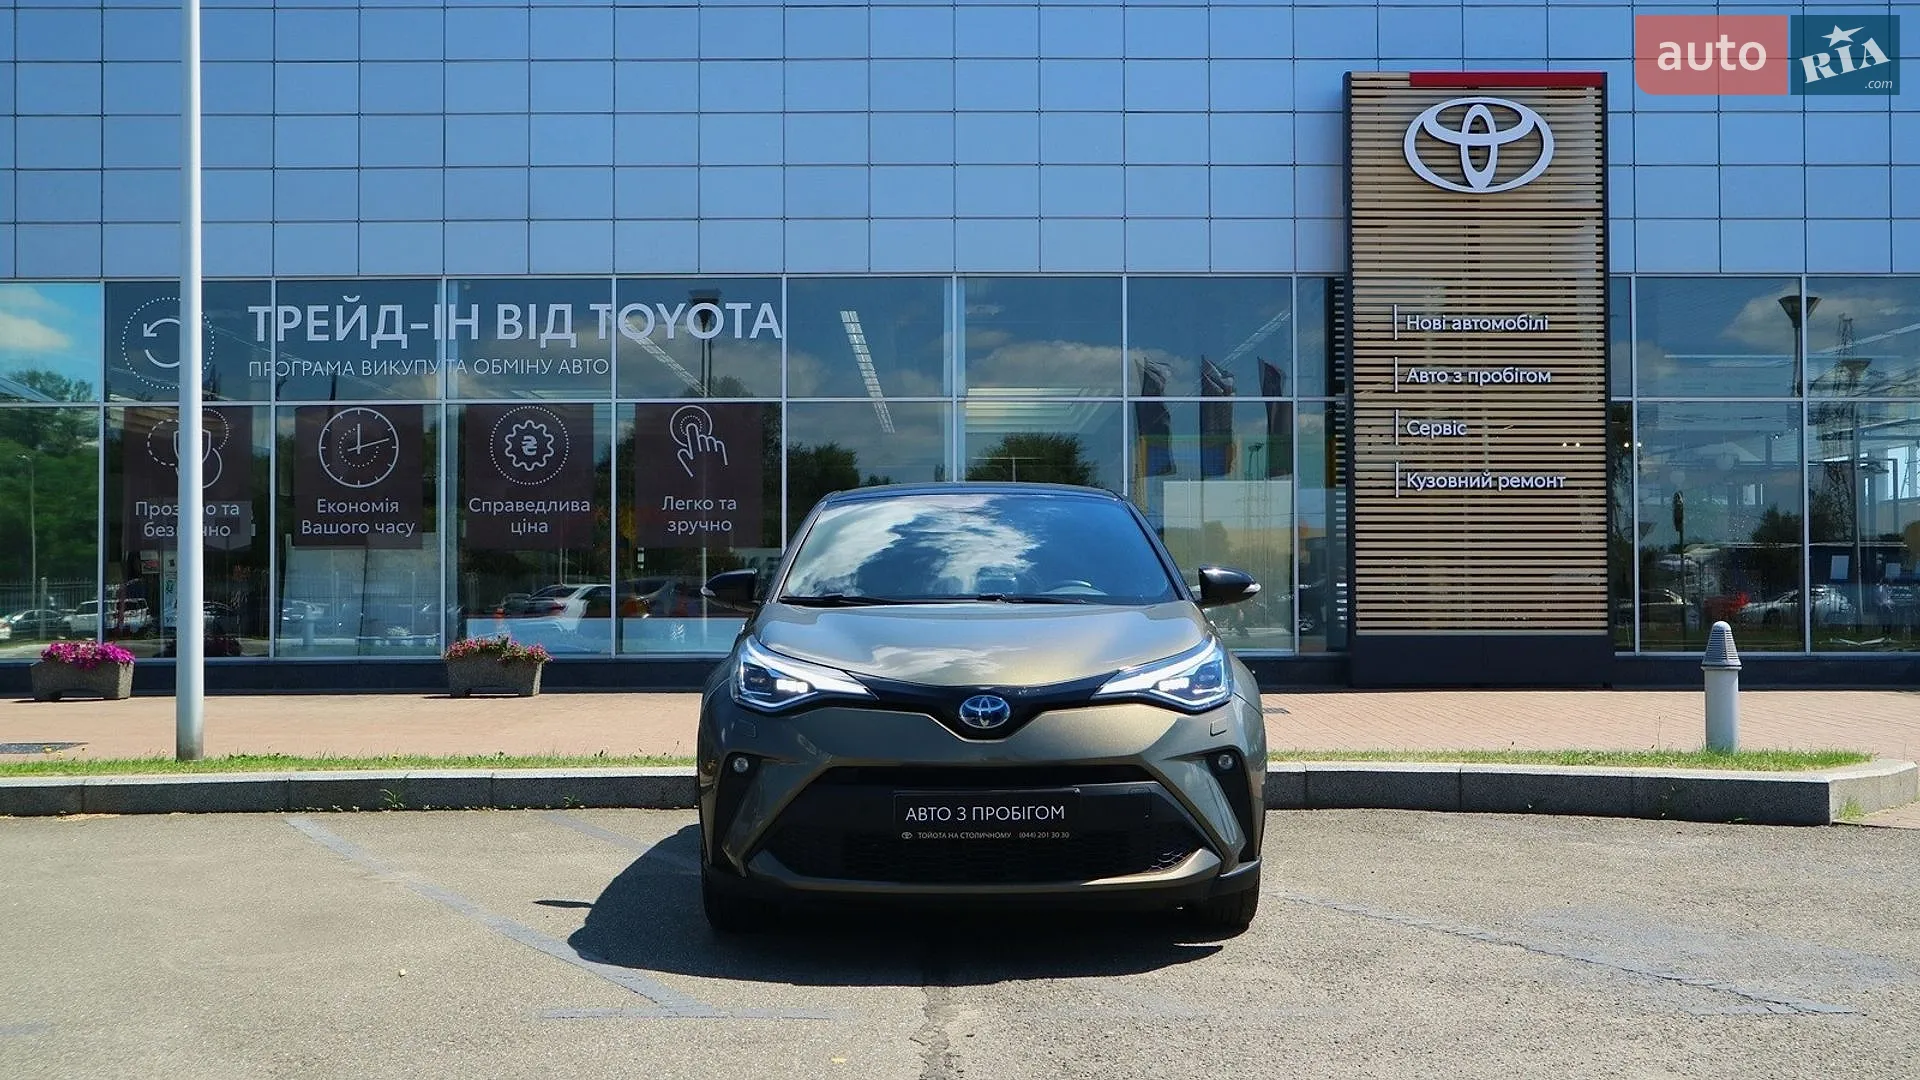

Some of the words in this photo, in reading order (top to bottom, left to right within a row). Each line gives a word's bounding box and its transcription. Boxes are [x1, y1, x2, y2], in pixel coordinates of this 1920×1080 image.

[248, 295, 479, 349] ТРЕЙД-ІН
[497, 303, 577, 349] ВІД
[589, 302, 783, 339] TOYOTA
[1406, 315, 1447, 331] Нові
[1452, 315, 1549, 331] автомобілі
[249, 360, 355, 377] ПРОГРАМА
[362, 359, 441, 376] ВИКУПУ
[446, 358, 468, 375] ТА
[474, 358, 552, 375] ОБМІНУ
[558, 358, 609, 375] АВТО
[1406, 368, 1449, 383] Авто
[1453, 372, 1462, 383] з
[1467, 367, 1551, 386] пробігом
[1406, 420, 1468, 439] Сервіс
[1406, 471, 1493, 491] Кузовний
[1498, 474, 1566, 491] ремонт
[135, 501, 216, 520] Прозо
[221, 504, 240, 516] та
[317, 497, 399, 513] Економія
[468, 497, 590, 516] Справедлива
[662, 495, 714, 511] Легко
[719, 499, 737, 510] та
[302, 519, 370, 534] Вашого
[375, 522, 416, 538] часу
[511, 518, 549, 535] ціна
[667, 519, 732, 535] зручно
[905, 806, 951, 821] АВТО
[956, 807, 967, 821] З
[972, 805, 1065, 821] ПРОБІГОМ
[918, 831, 947, 840] ТОЙОТА
[948, 831, 959, 839] НА
[1018, 831, 1037, 840] (044)
[1037, 831, 1050, 839] 201
